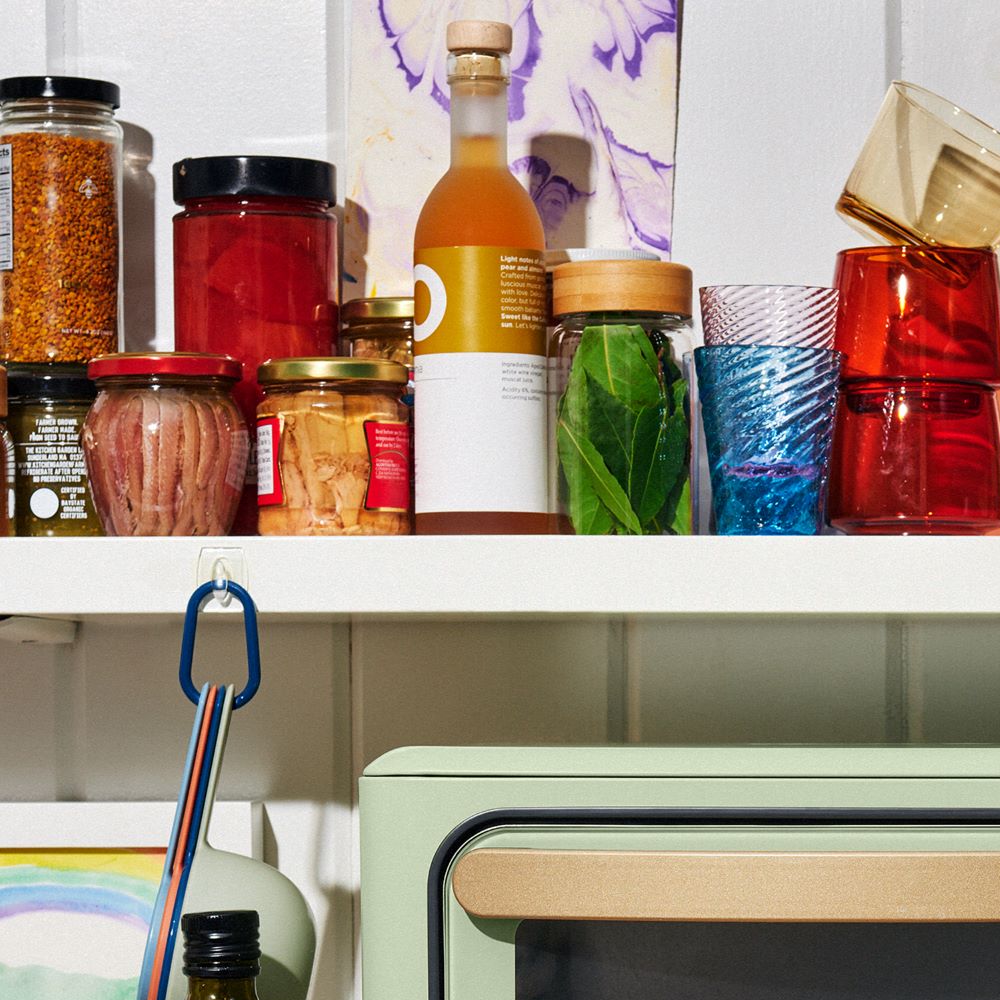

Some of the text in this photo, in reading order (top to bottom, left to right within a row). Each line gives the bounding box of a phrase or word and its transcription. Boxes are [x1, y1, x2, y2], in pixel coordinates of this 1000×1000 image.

[500, 255, 518, 264] Light
[517, 264, 528, 272] and
[500, 313, 521, 321] Sweet
